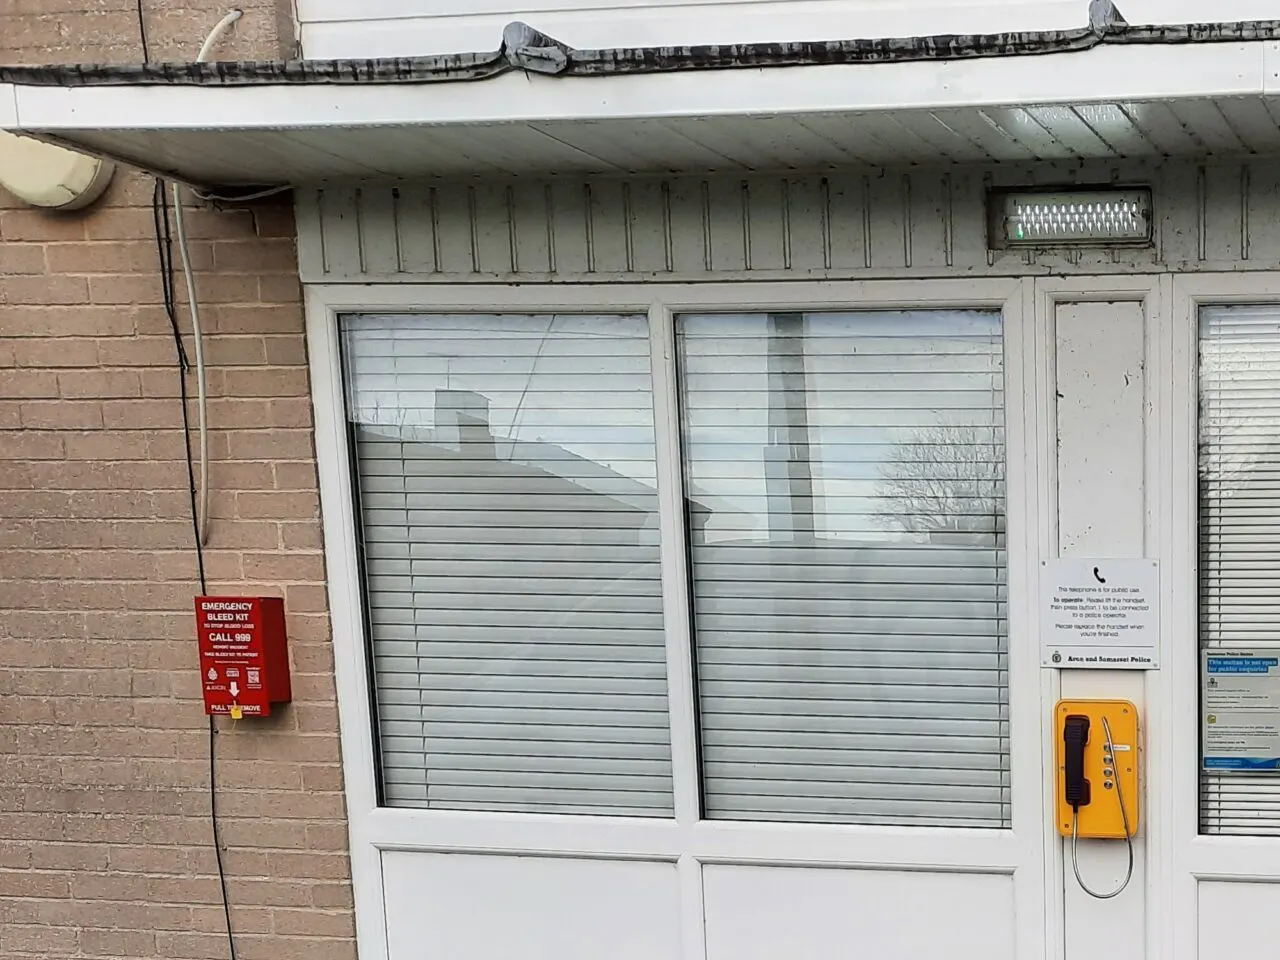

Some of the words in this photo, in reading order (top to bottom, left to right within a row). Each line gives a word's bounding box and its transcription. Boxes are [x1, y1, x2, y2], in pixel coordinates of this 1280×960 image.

[201, 602, 252, 610] EMERGENCY
[207, 613, 233, 621] BLEED
[235, 613, 249, 621] KIT
[209, 633, 233, 642] CALL
[235, 633, 251, 642] 999
